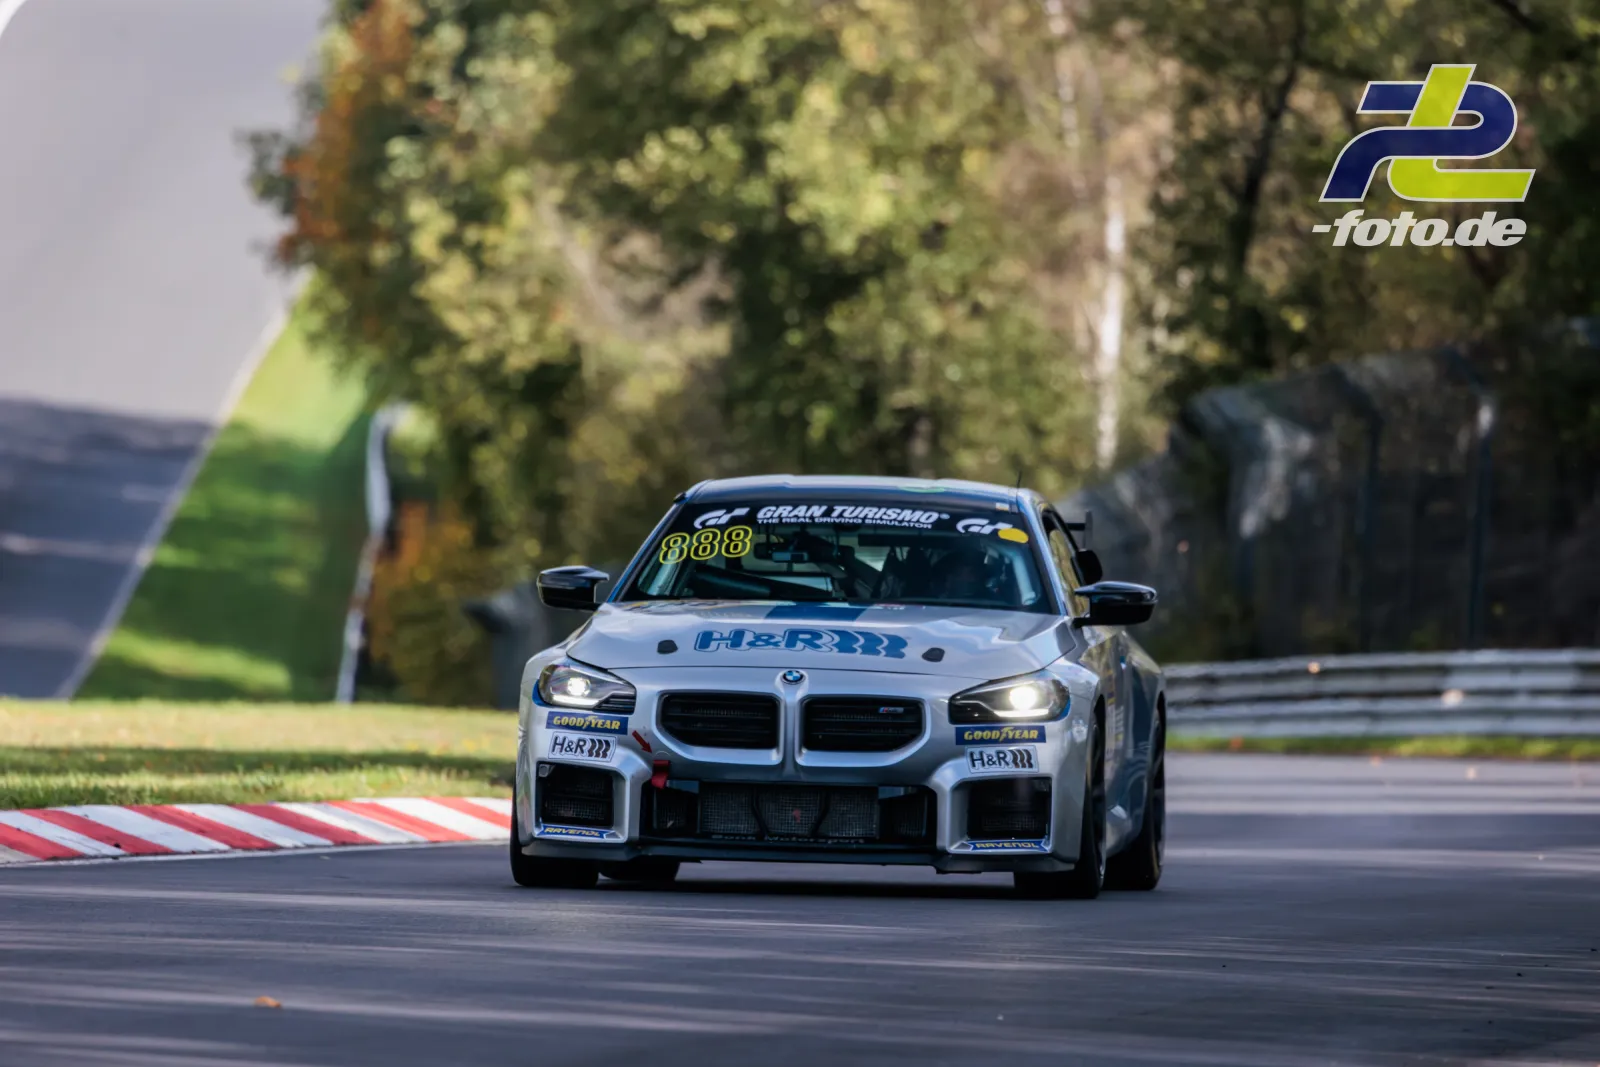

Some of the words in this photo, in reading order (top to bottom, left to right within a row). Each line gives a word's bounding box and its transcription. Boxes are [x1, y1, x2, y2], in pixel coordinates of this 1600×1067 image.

[756, 505, 828, 518] GRAN
[832, 505, 940, 524] TURISMO
[815, 516, 863, 524] DRIVING
[865, 518, 933, 529] SIMULATOR
[659, 525, 753, 565] 888
[694, 628, 836, 652] H&R
[552, 715, 621, 730] GOODYEAR
[963, 726, 1039, 742] GOODYEAR
[551, 734, 588, 755] H&R
[969, 749, 1010, 768] H&R
[544, 827, 600, 837] RAVENOL
